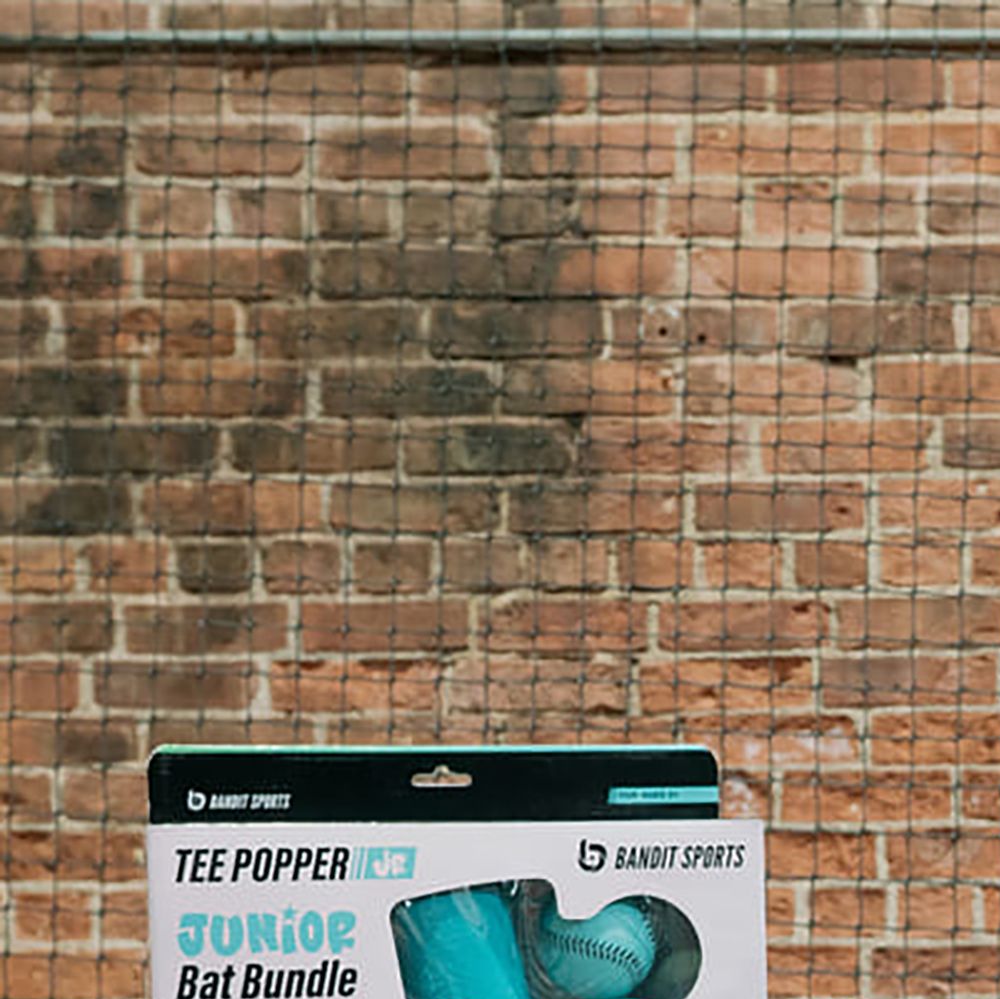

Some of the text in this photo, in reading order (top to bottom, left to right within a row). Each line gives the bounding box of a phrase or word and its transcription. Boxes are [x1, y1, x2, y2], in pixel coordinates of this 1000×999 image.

[175, 848, 228, 883] TEE
[231, 846, 350, 882] POPPER
[615, 845, 680, 870] BANDIT
[681, 844, 746, 869] SPORTS
[241, 959, 358, 999] Bundle
